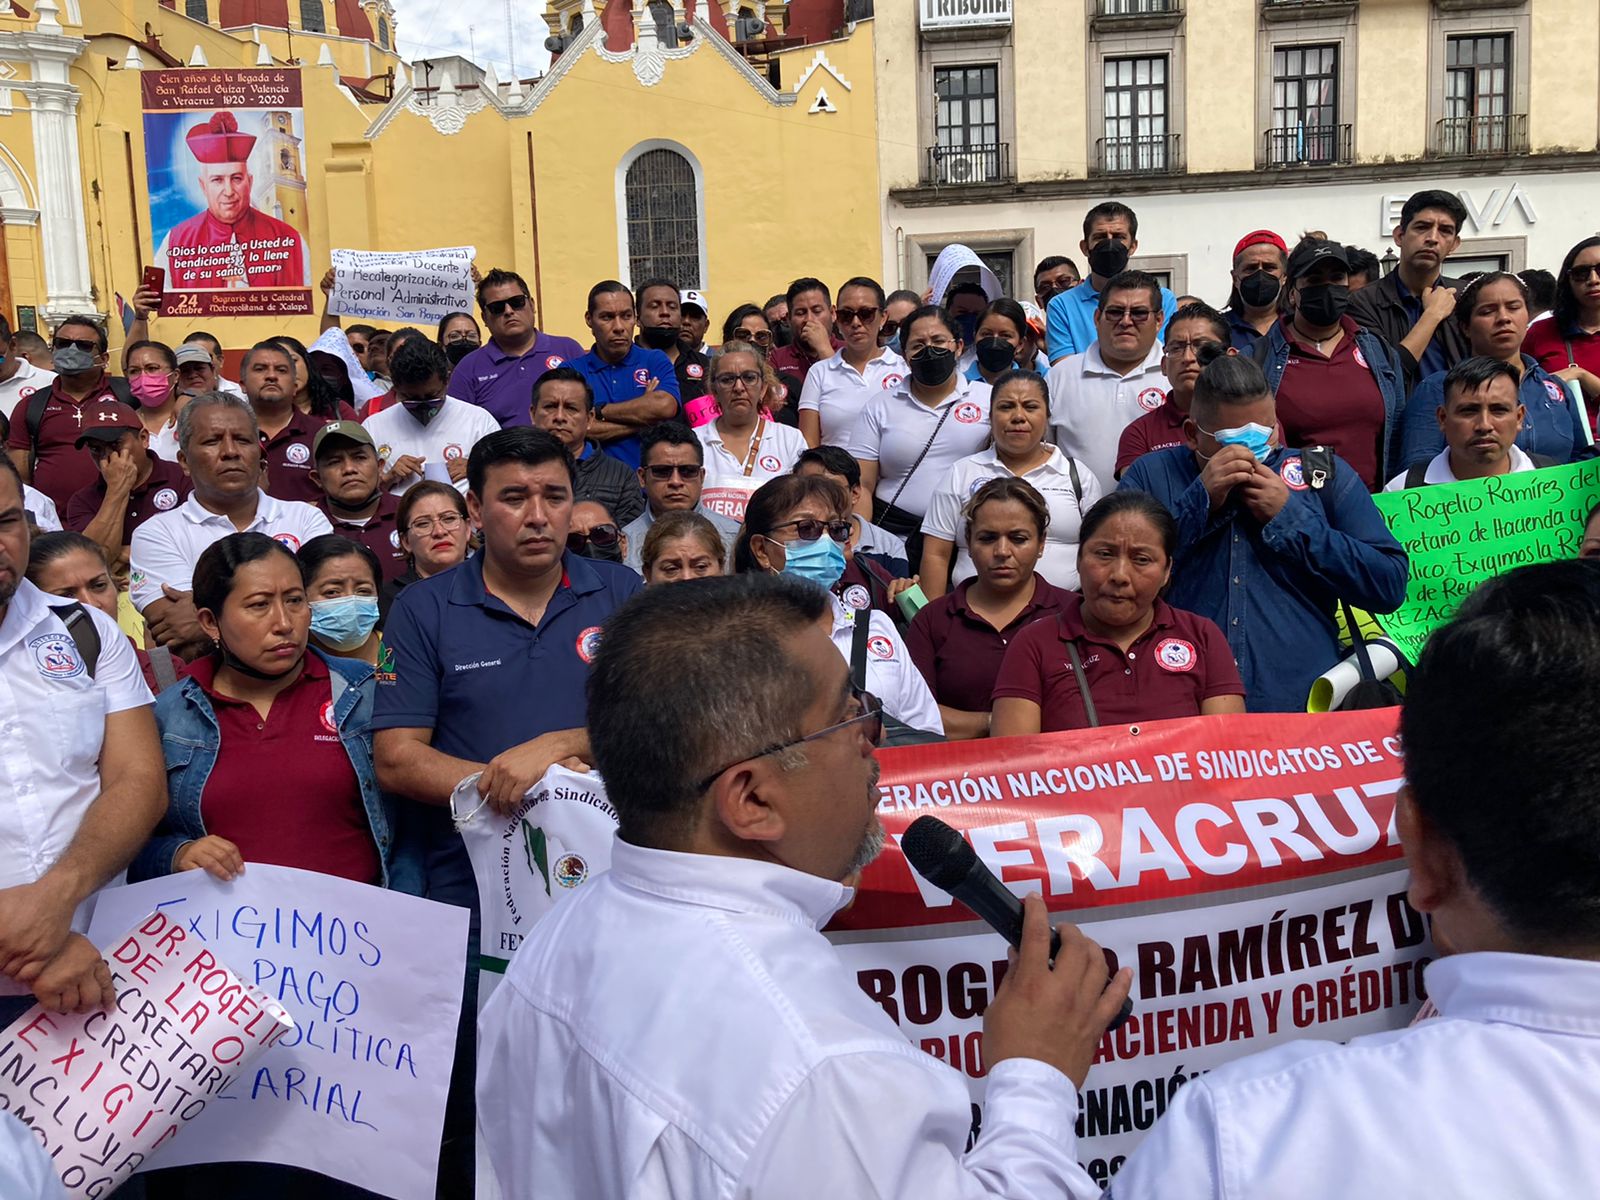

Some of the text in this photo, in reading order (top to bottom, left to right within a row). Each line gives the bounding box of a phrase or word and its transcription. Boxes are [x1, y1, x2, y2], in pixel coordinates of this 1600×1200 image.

[159, 72, 285, 85] Cien años de la llegada de
[155, 84, 290, 96] San Rafael Guízar Valencia
[162, 99, 169, 107] a
[173, 97, 215, 106] Veracruz
[222, 95, 246, 106] 1920
[258, 95, 285, 105] 2020
[197, 243, 209, 256] lo
[209, 242, 241, 254] colme
[241, 242, 248, 251] a
[249, 238, 281, 249] Usted
[281, 236, 296, 248] de
[174, 250, 290, 269] bendiciones y lo llene
[413, 258, 460, 274] Docente
[463, 267, 470, 279] y
[182, 270, 197, 281] de
[200, 270, 213, 280] su
[215, 266, 245, 278] santo
[332, 281, 469, 309] Personal Administrativo
[451, 279, 469, 292] del
[177, 293, 198, 308] 24
[248, 293, 258, 302] de
[260, 293, 269, 302] la
[271, 292, 305, 302] Catedral
[167, 305, 203, 316] Octubre
[209, 302, 309, 314] Metropolitana de Xalapa
[335, 300, 391, 319] Delegación
[395, 305, 416, 319] San
[706, 500, 748, 517] VERA
[1402, 492, 1484, 527] Rogelio
[1483, 475, 1566, 505] Ramírez
[1401, 530, 1461, 553] retario
[1468, 520, 1490, 543] de
[1492, 509, 1566, 539] Hacienda
[1570, 508, 1585, 529] y
[1451, 545, 1532, 578] Exigimos
[1536, 538, 1553, 560] la
[1416, 584, 1438, 602] de
[454, 657, 502, 671] Dirección General
[877, 771, 1004, 814] ERACIÓN
[1008, 758, 1153, 799] NACIONAL
[1152, 750, 1194, 783] DE
[1197, 744, 1342, 781] SINDICATOS
[1341, 739, 1385, 767] DE
[500, 846, 523, 926] Federación
[138, 911, 187, 958] DR.
[155, 897, 382, 967] XIGIMOS
[1136, 898, 1380, 1001] RAMÍREZ
[252, 958, 360, 1022] PAGO
[113, 935, 246, 1067] DE LA O.
[1090, 996, 1252, 1066] ACIENDA
[1261, 988, 1283, 1034] Y
[1291, 957, 1430, 1029] CRÉDITO
[83, 1010, 207, 1122] CRÉDITO
